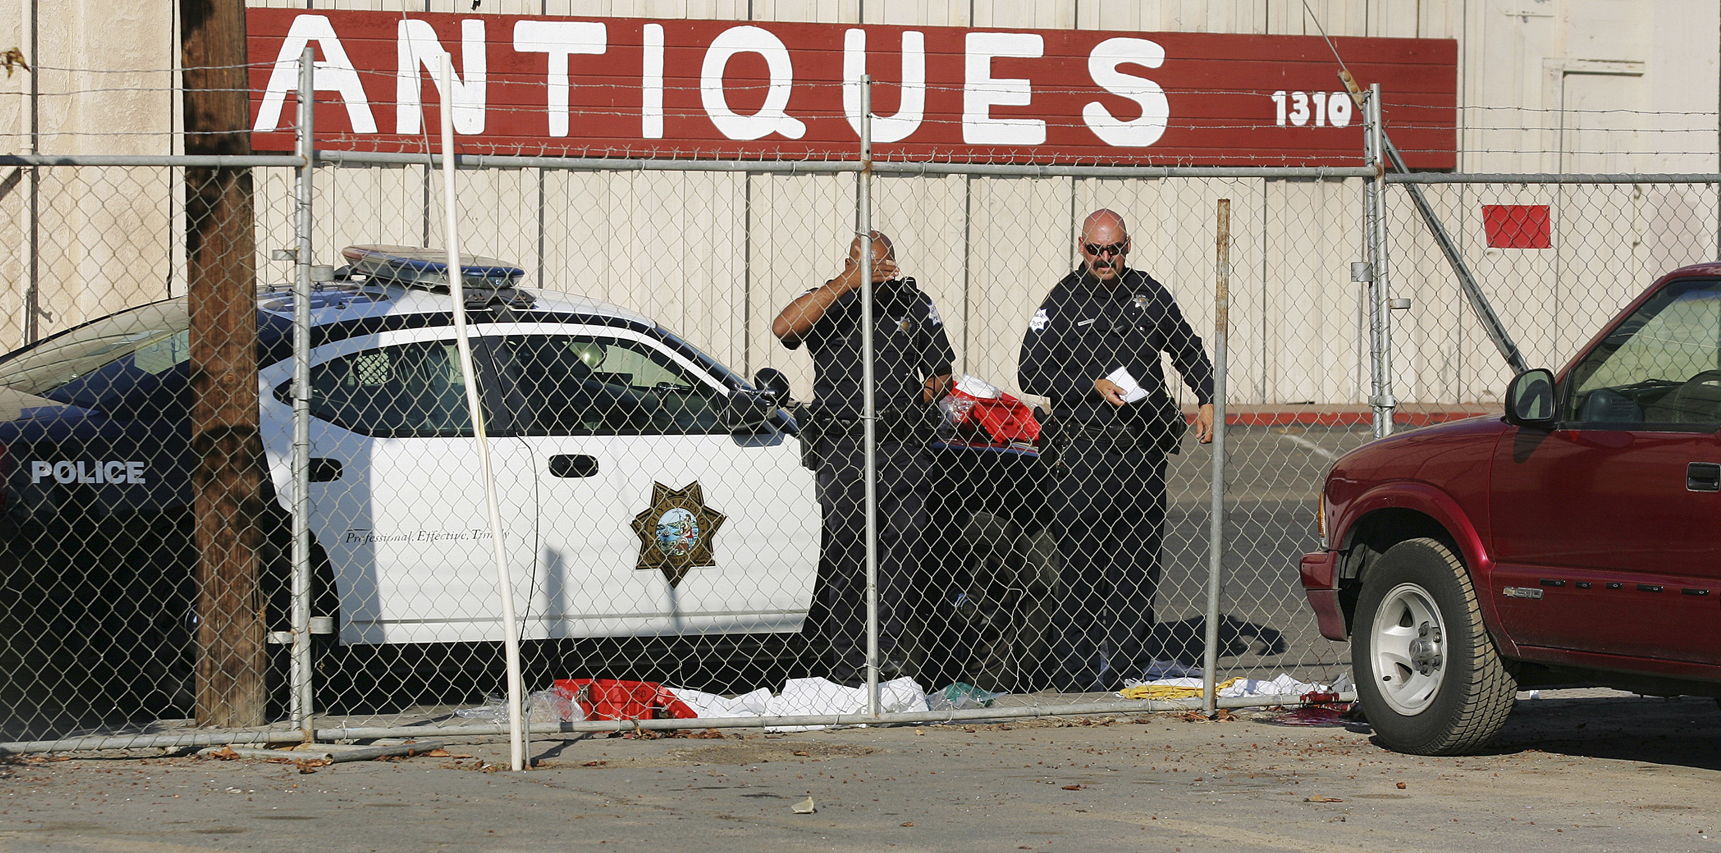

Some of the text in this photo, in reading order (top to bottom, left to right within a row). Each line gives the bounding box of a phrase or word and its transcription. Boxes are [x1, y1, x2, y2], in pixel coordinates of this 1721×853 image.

[253, 14, 1170, 147] ANTIQUES
[1271, 90, 1352, 128] 1310
[31, 460, 146, 484] POLICE
